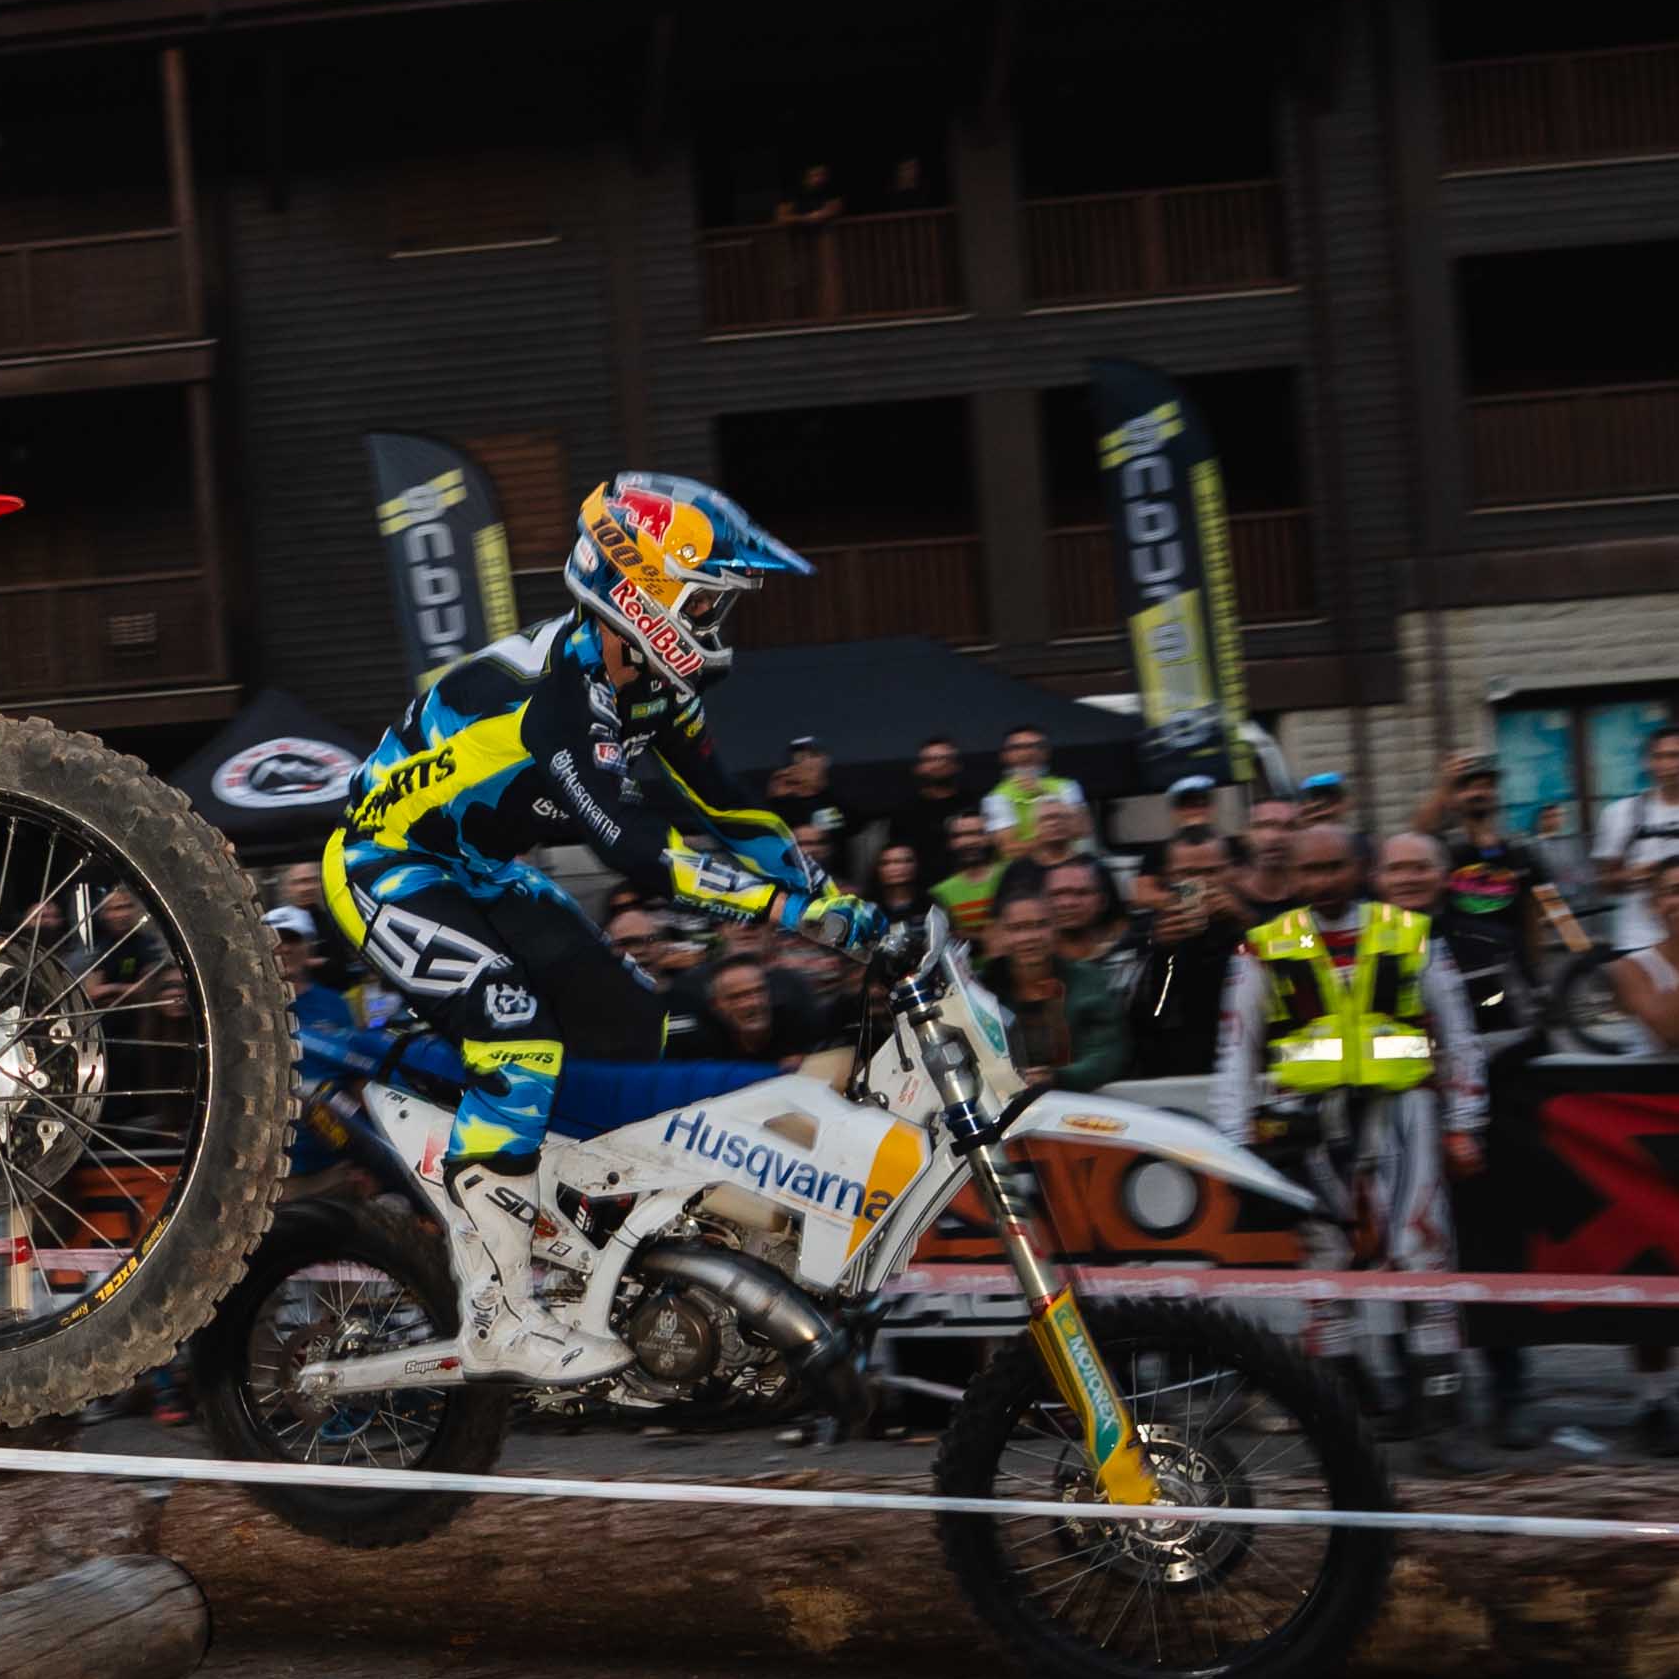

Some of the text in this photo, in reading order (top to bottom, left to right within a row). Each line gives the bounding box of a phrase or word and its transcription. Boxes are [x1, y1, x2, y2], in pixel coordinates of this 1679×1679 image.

[609, 577, 667, 640] Red
[647, 619, 706, 679] Bull
[560, 762, 622, 843] Husqvarna
[659, 1108, 896, 1224] Husqvarna
[95, 1256, 139, 1303] EXCEL
[1068, 1335, 1120, 1435] MOTOREX
